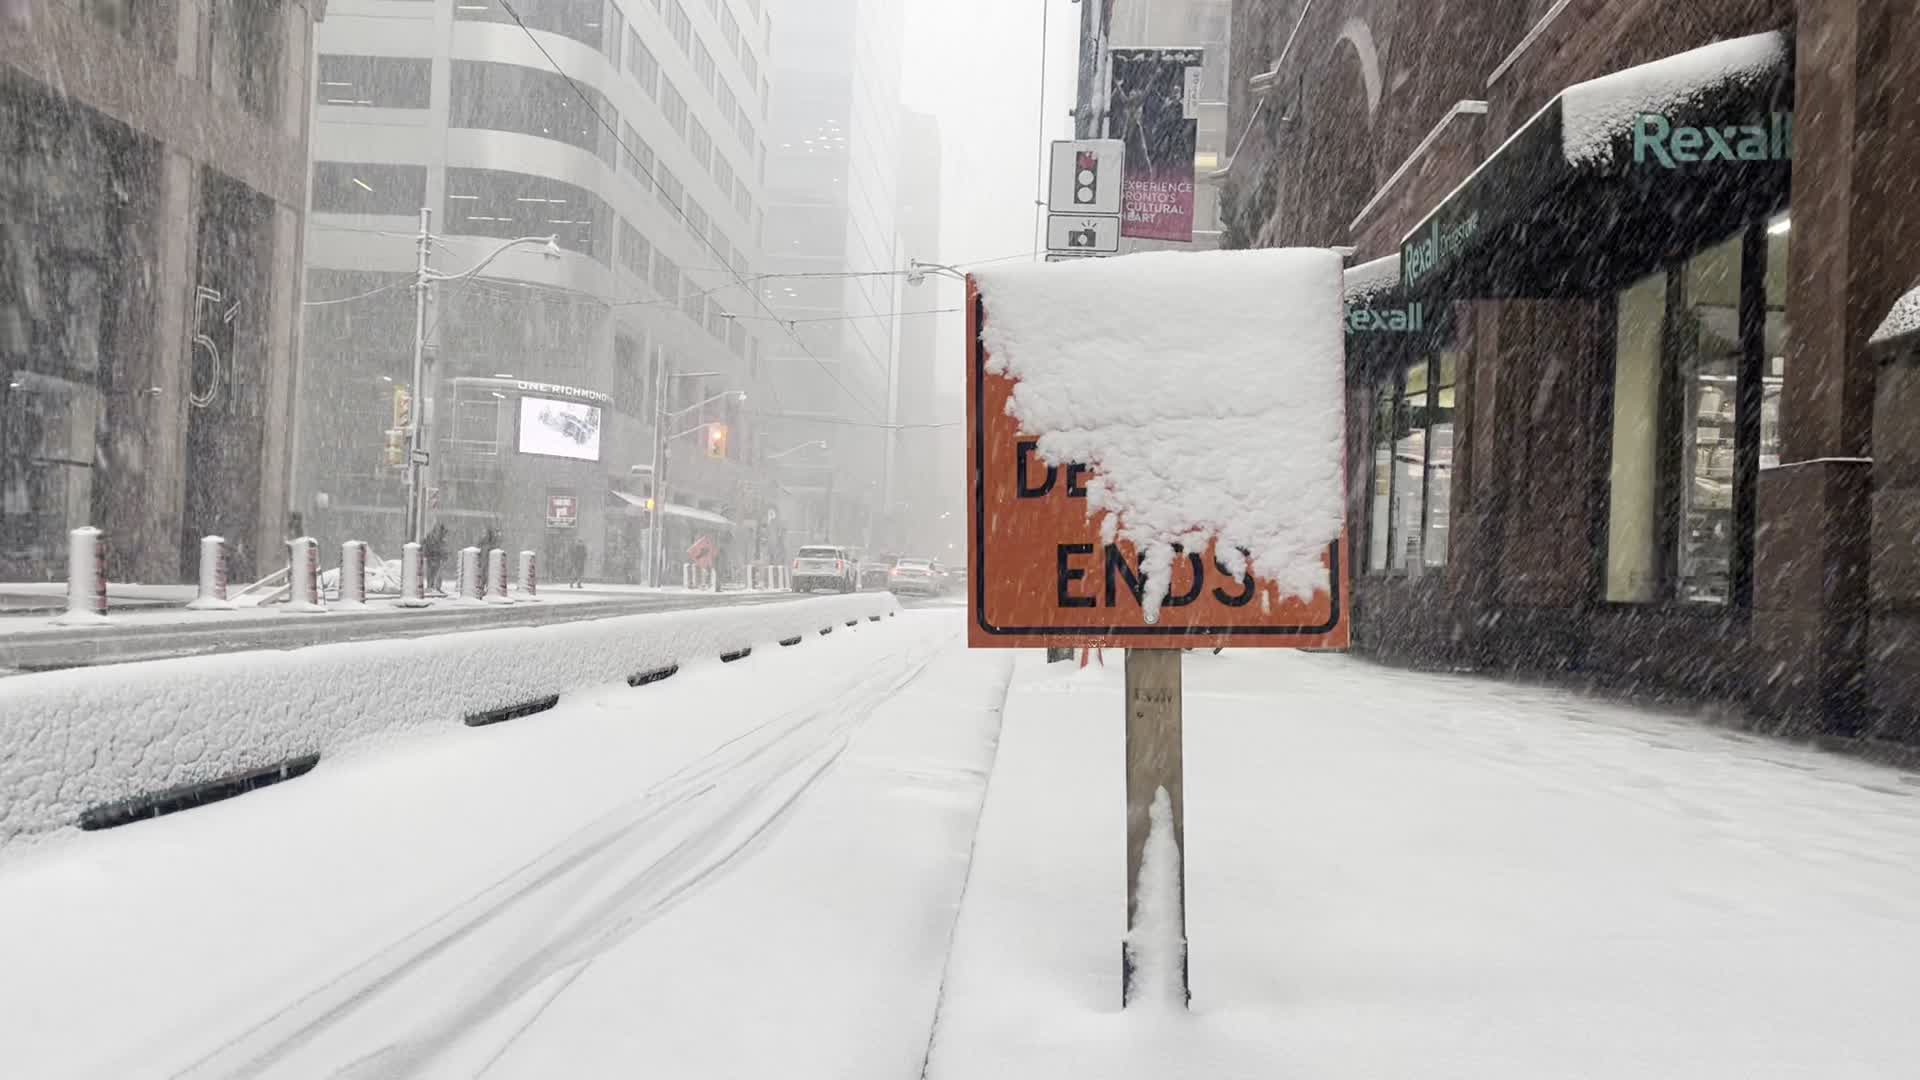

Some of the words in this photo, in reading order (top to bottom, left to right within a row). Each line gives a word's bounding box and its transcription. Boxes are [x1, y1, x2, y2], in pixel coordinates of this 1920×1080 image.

[1633, 112, 1793, 169] Rexall
[1121, 191, 1176, 203] RONTO'S
[1123, 180, 1193, 193] EXPERIENCE
[1126, 202, 1184, 215] CULTURAL
[1404, 216, 1439, 289] Rexall
[190, 285, 241, 416] 51
[517, 381, 549, 392] ONE
[551, 385, 608, 401] RICHMOND
[1056, 541, 1255, 608] ENDS
